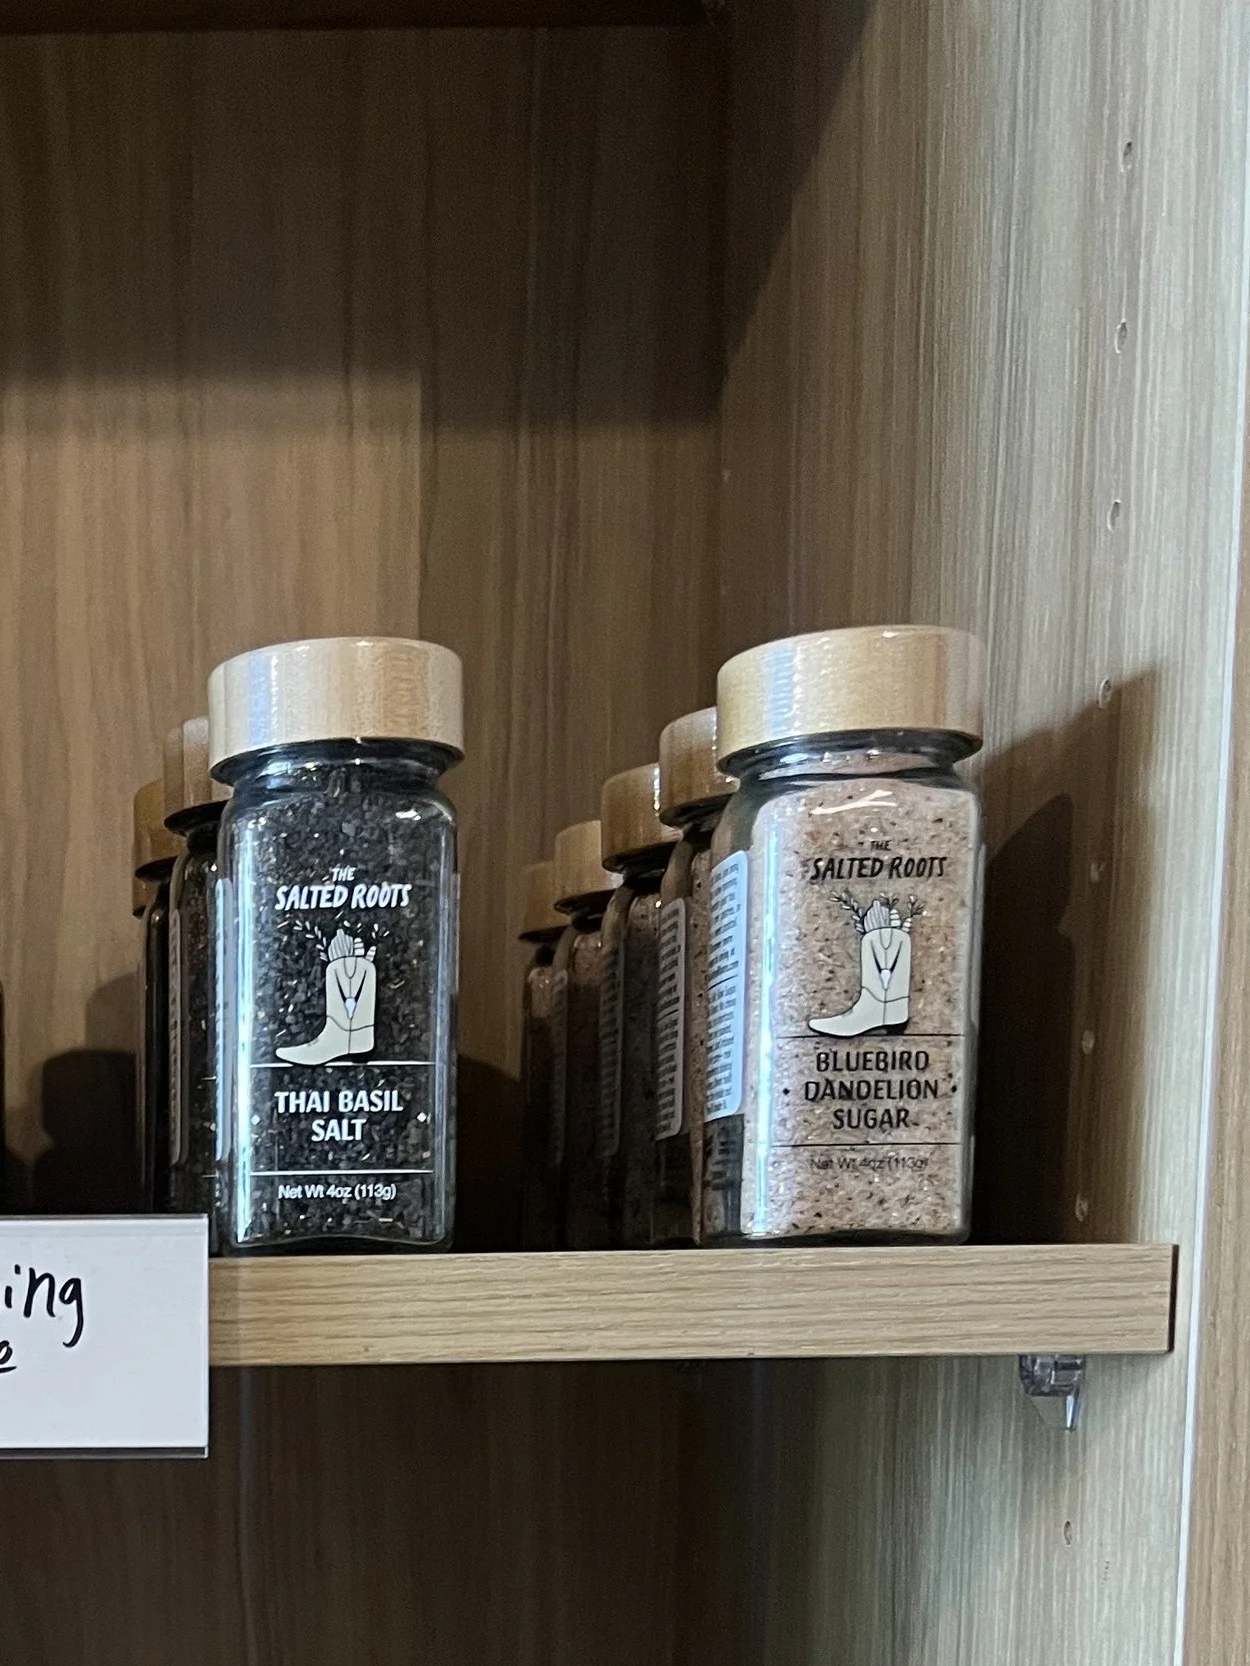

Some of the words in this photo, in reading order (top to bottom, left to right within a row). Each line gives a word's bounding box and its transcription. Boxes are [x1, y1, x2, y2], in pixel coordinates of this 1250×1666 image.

[870, 839, 892, 852] THE
[331, 866, 356, 883] THE
[809, 856, 883, 880] SALTED
[887, 855, 947, 879] ROOTS
[274, 884, 348, 911] SALTED
[350, 883, 413, 909] ROOTS
[815, 1050, 930, 1073] BLUEBIRD
[803, 1079, 939, 1101] DANDELION
[273, 1090, 331, 1114] THAI
[337, 1089, 404, 1113] BASIL
[832, 1108, 910, 1130] SUGAR
[310, 1118, 367, 1143] SALT
[810, 1157, 834, 1171] Net
[277, 1185, 302, 1200] Net
[303, 1185, 326, 1200] Wt
[327, 1185, 352, 1199] 4oz
[354, 1183, 397, 1201] (113g)
